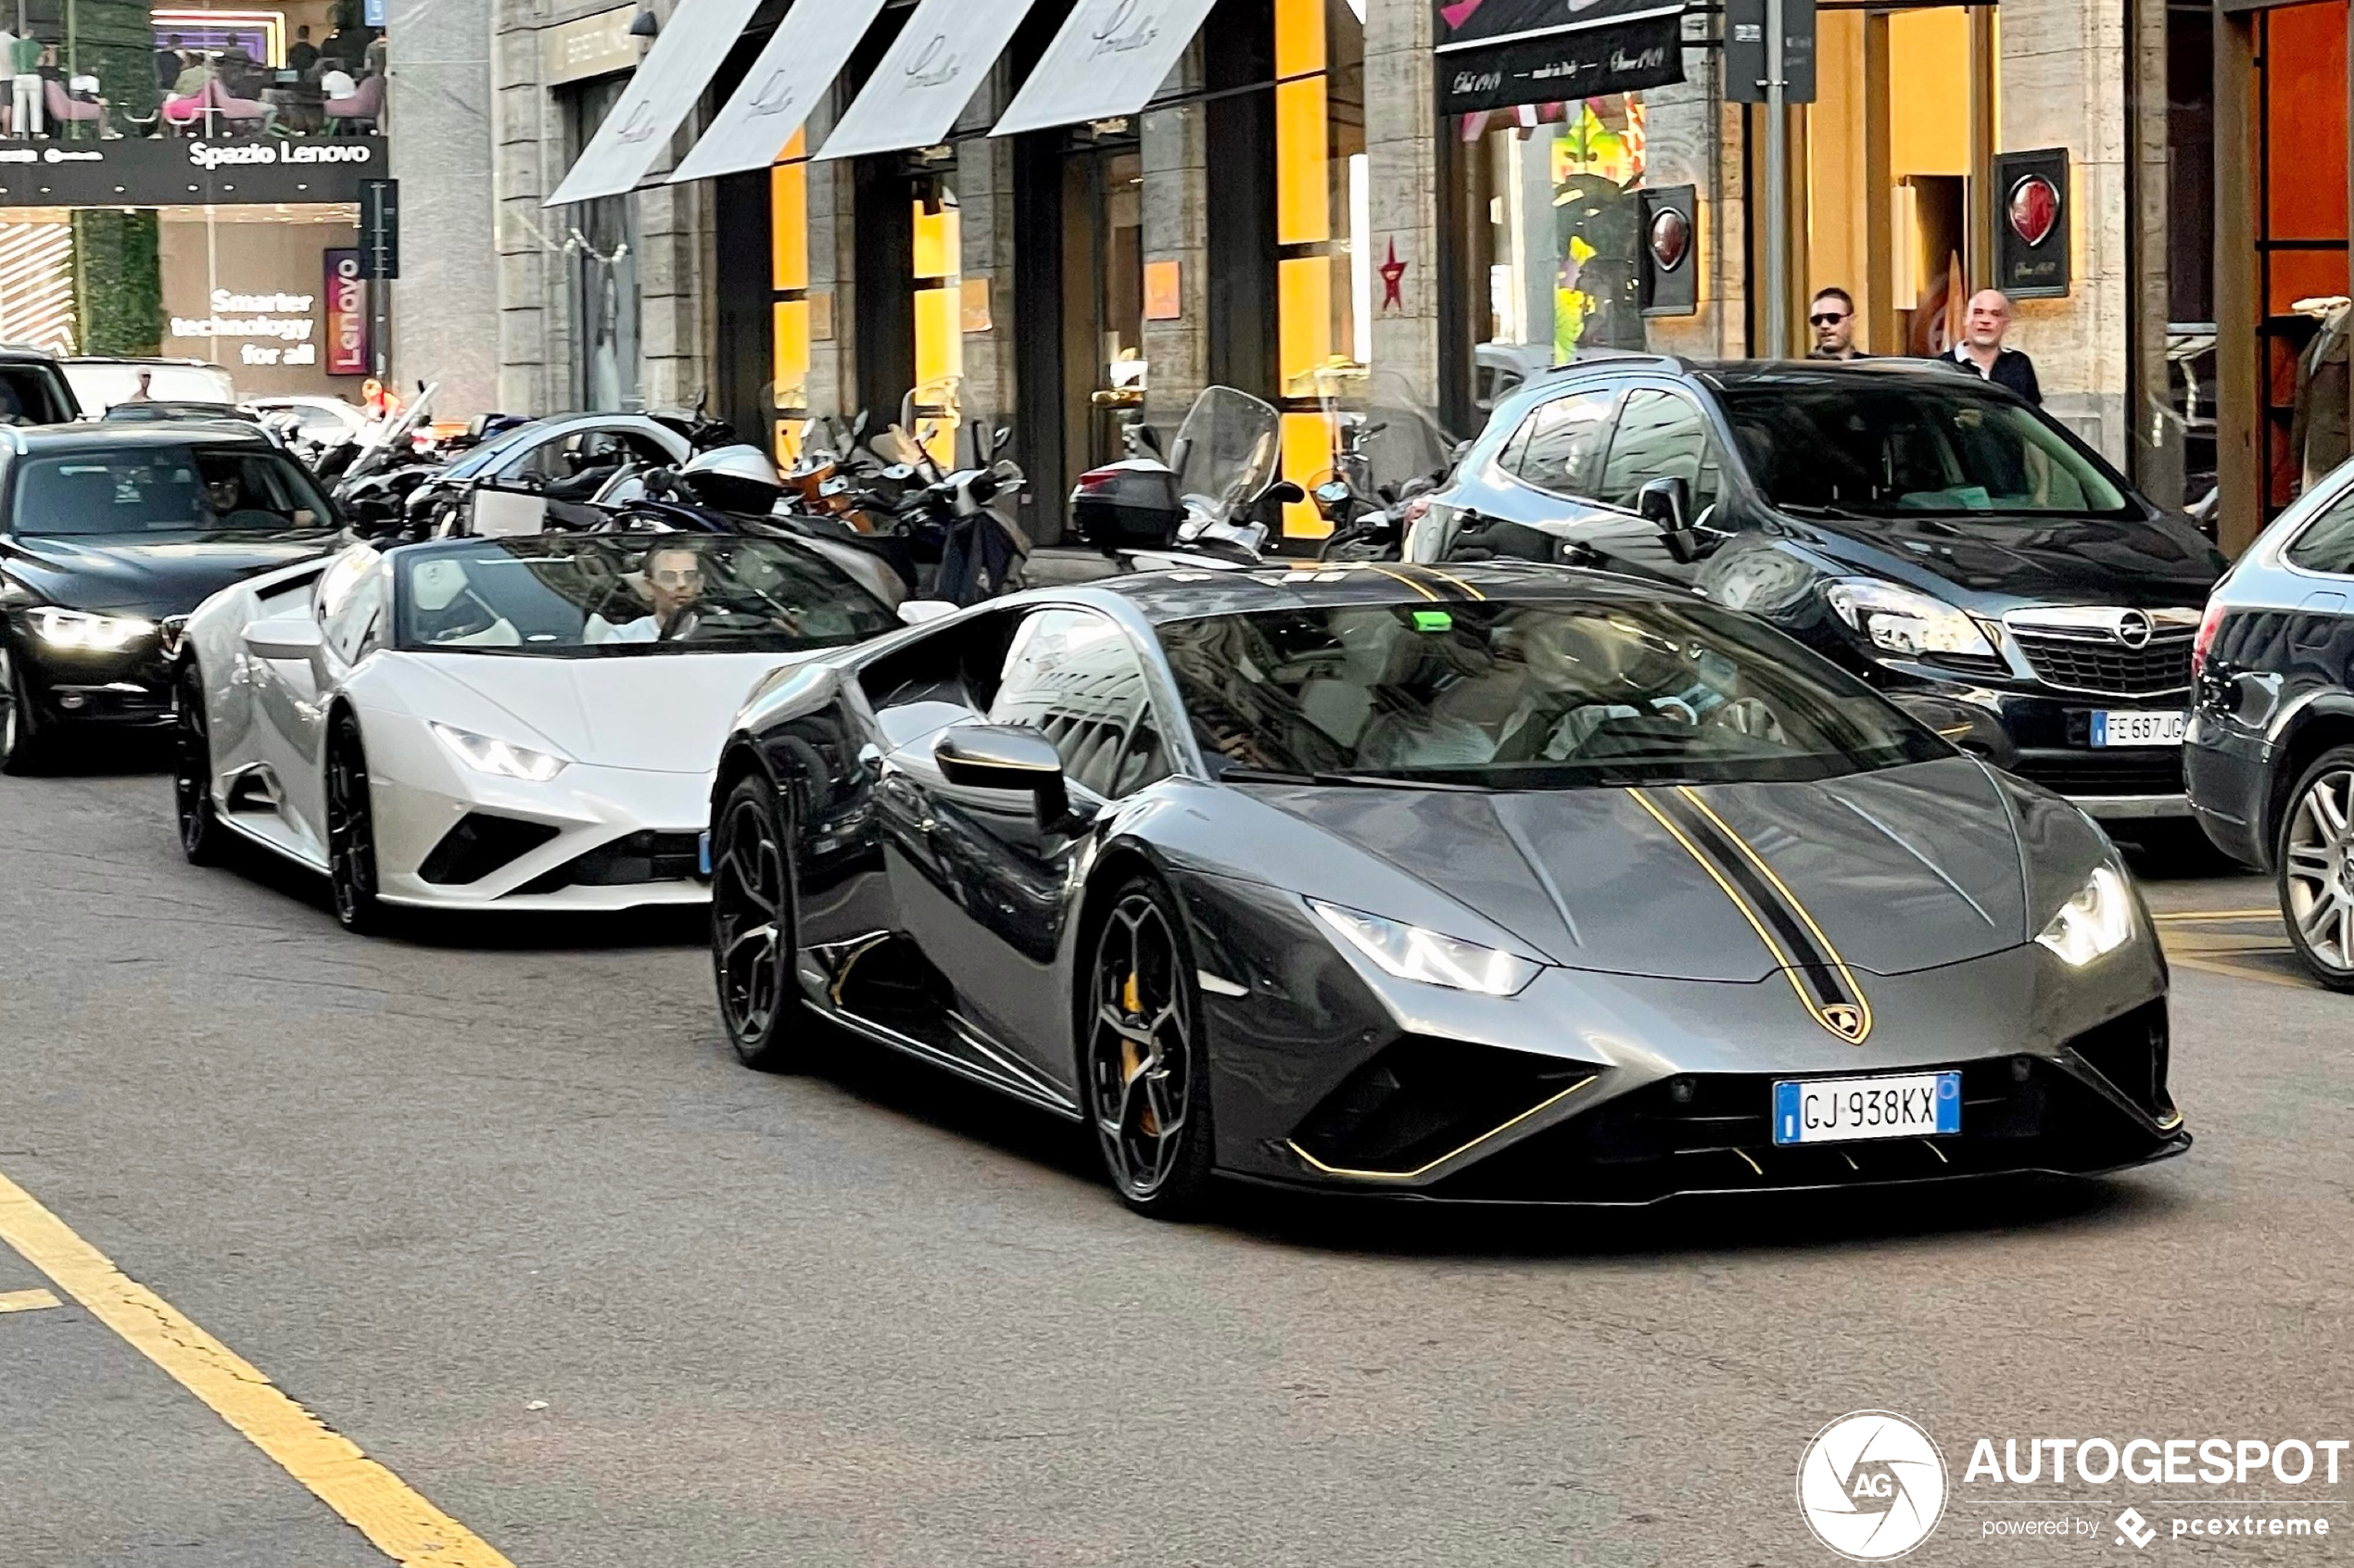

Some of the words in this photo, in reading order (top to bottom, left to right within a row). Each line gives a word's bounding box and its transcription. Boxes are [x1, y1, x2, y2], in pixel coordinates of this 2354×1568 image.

[188, 140, 277, 171] Spazio
[280, 139, 371, 164] Lenovo
[209, 288, 315, 312] Smarter
[335, 259, 361, 366] Lenovo
[170, 315, 314, 341] technology
[240, 343, 281, 365] for
[282, 343, 315, 365] all
[1803, 1093, 1838, 1130] GJ
[1849, 1087, 1934, 1128] 938KX
